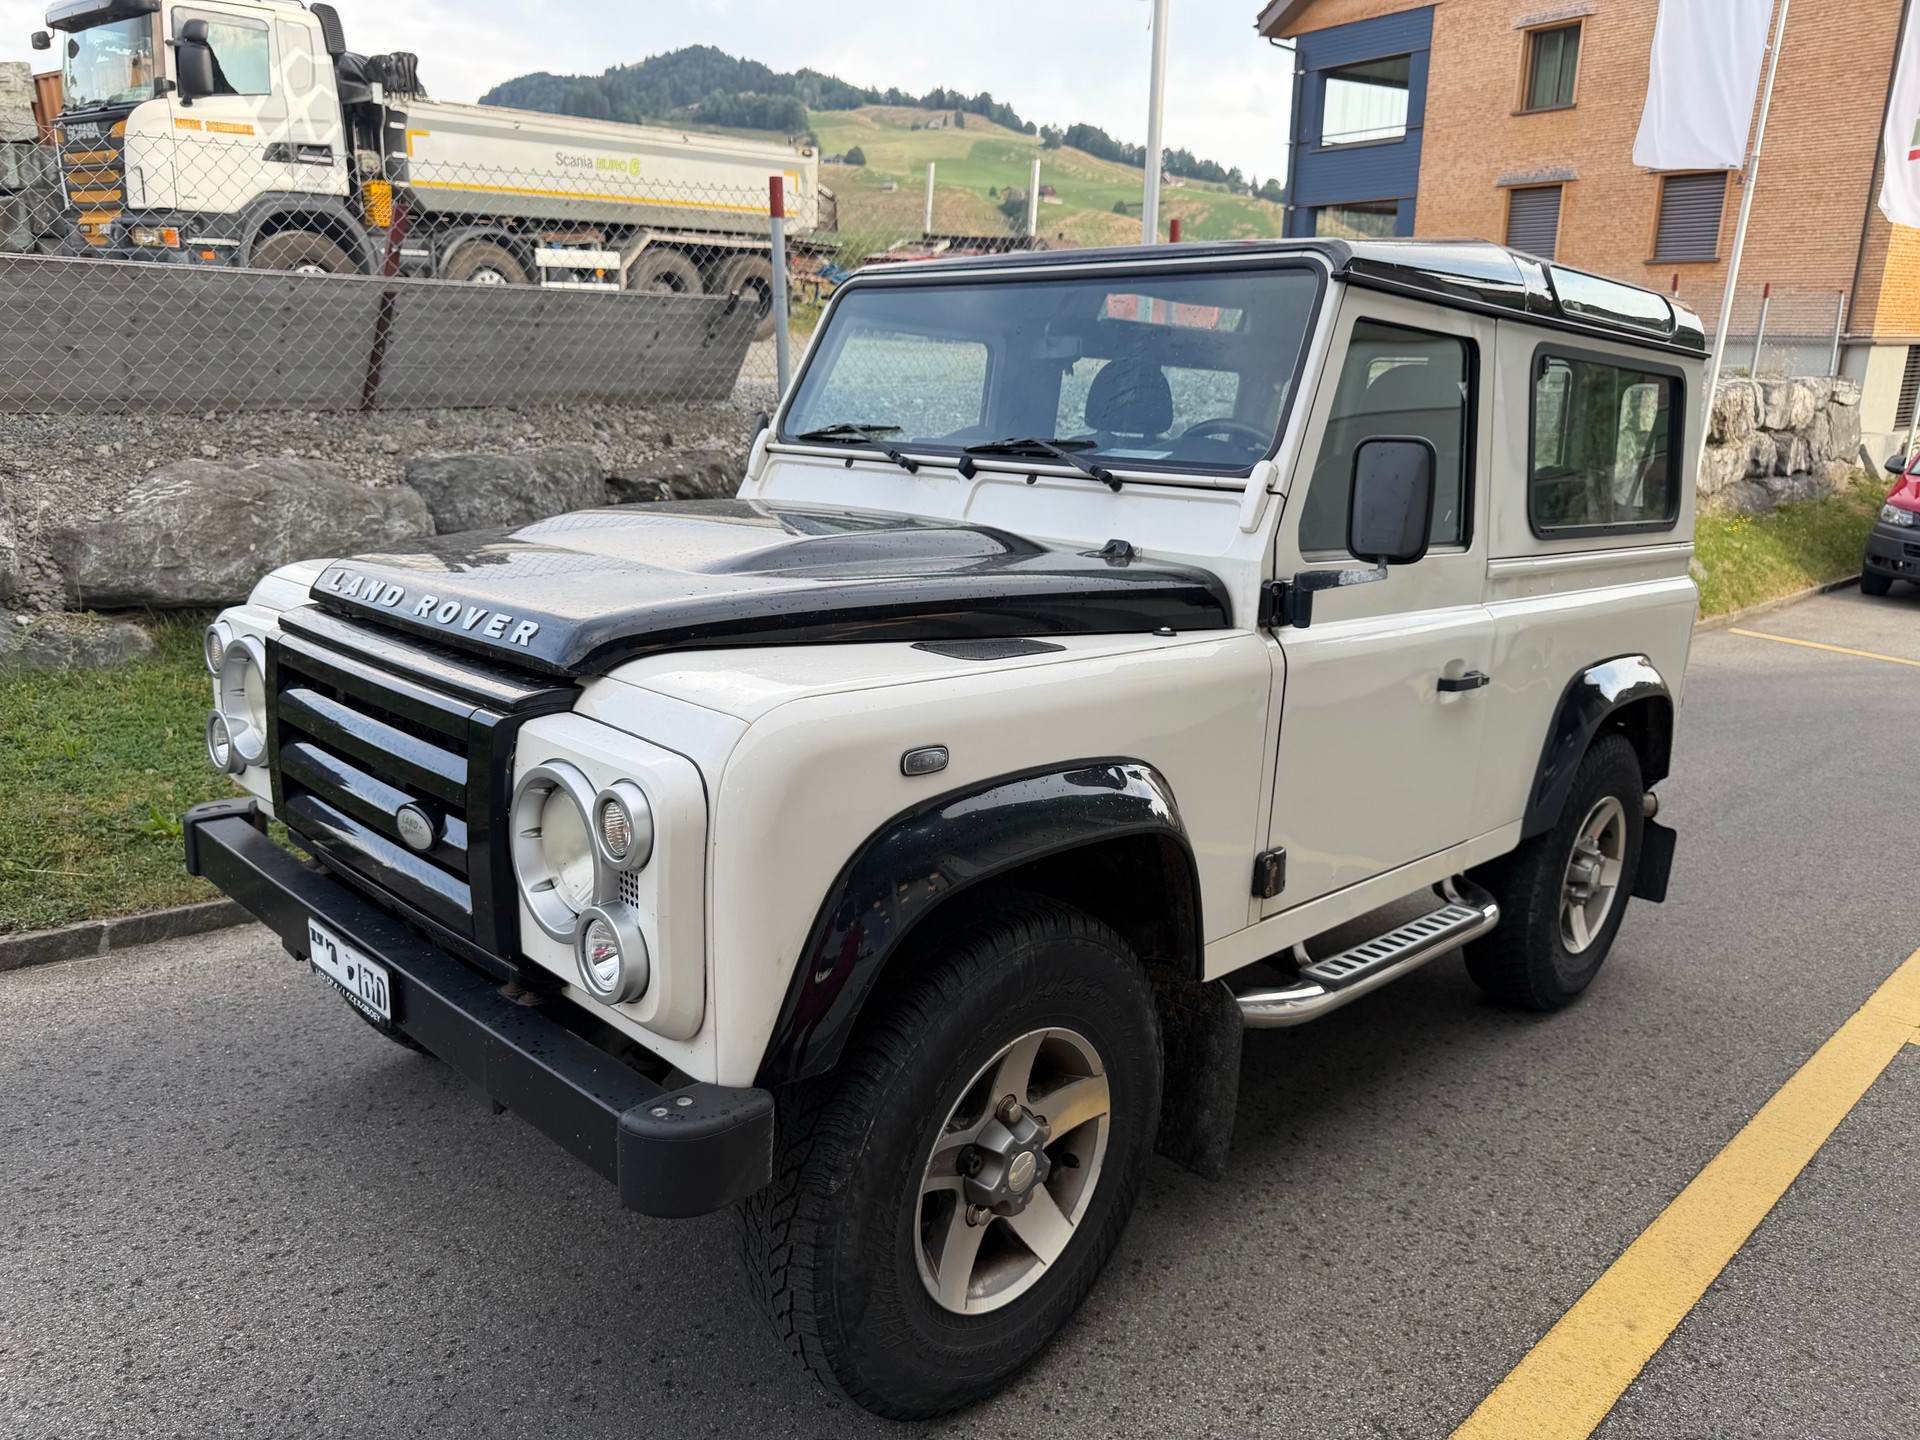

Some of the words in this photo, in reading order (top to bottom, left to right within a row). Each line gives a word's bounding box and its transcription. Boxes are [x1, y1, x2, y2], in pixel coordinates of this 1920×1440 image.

[555, 151, 593, 169] Scania
[629, 157, 641, 176] 6
[328, 572, 406, 608] LAND
[412, 594, 540, 647] ROVER
